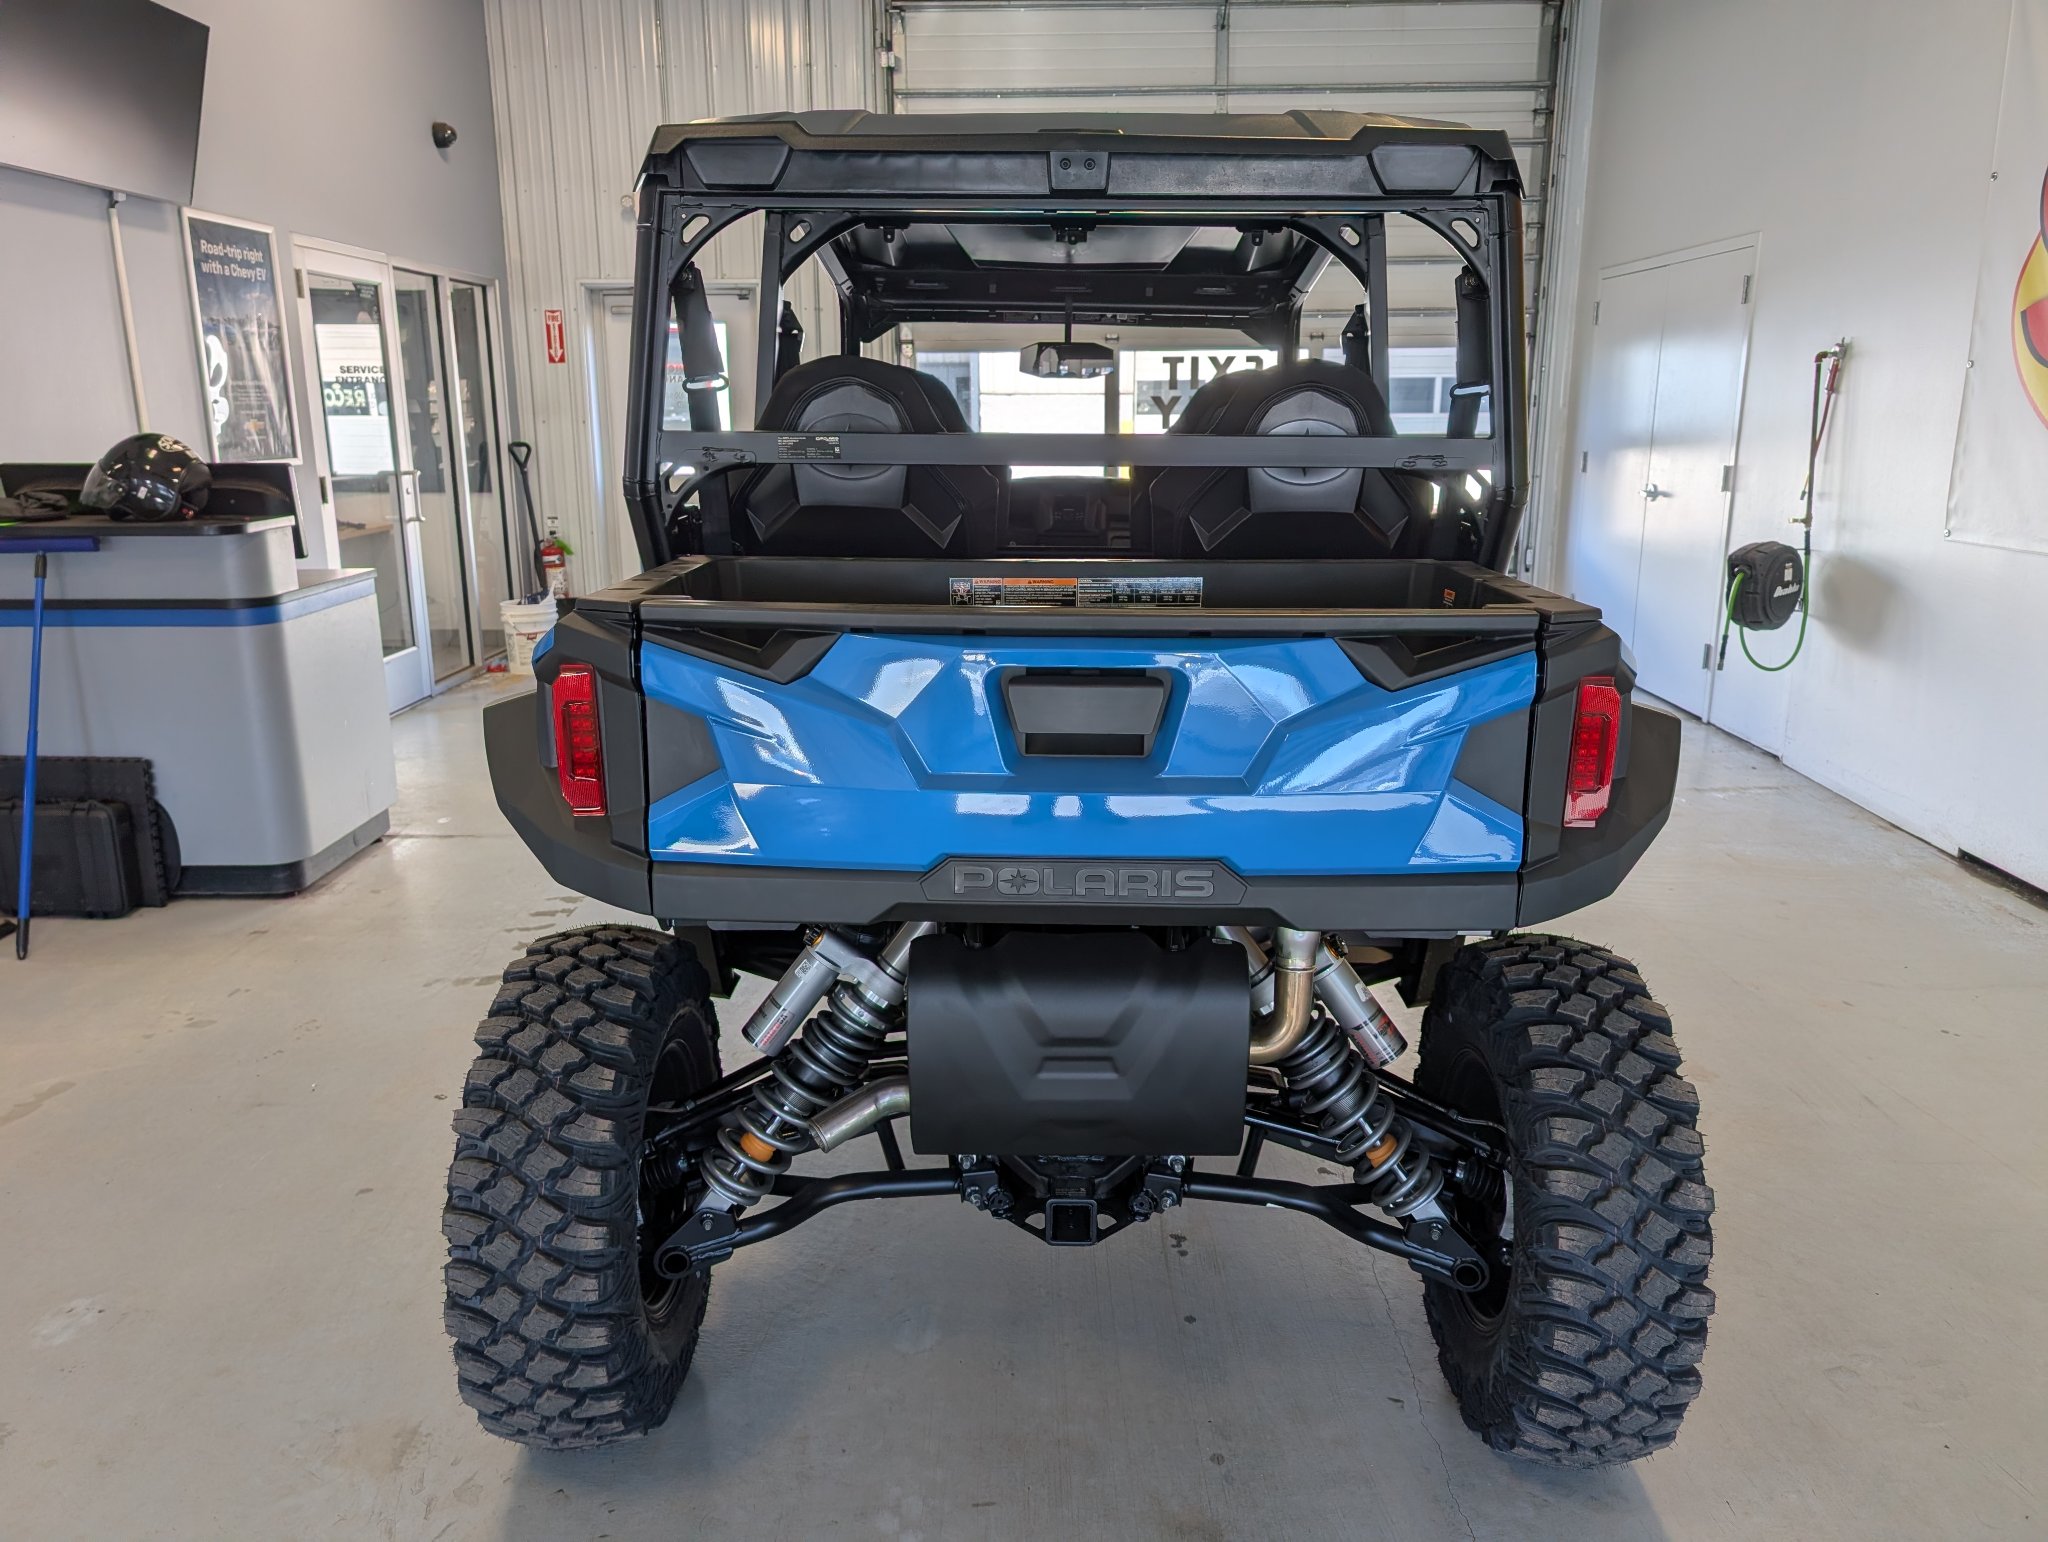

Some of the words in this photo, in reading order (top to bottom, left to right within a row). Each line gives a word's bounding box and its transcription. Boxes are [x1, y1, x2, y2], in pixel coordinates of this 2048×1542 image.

[200, 239, 242, 261] Road-trip
[243, 247, 263, 264] right
[201, 260, 223, 275] with
[224, 265, 230, 276] a
[231, 263, 256, 282] Chevy
[256, 267, 266, 281] EV
[335, 375, 386, 384] ENTRANC
[339, 365, 385, 374] SERVICE
[954, 866, 1215, 898] POLARIS
